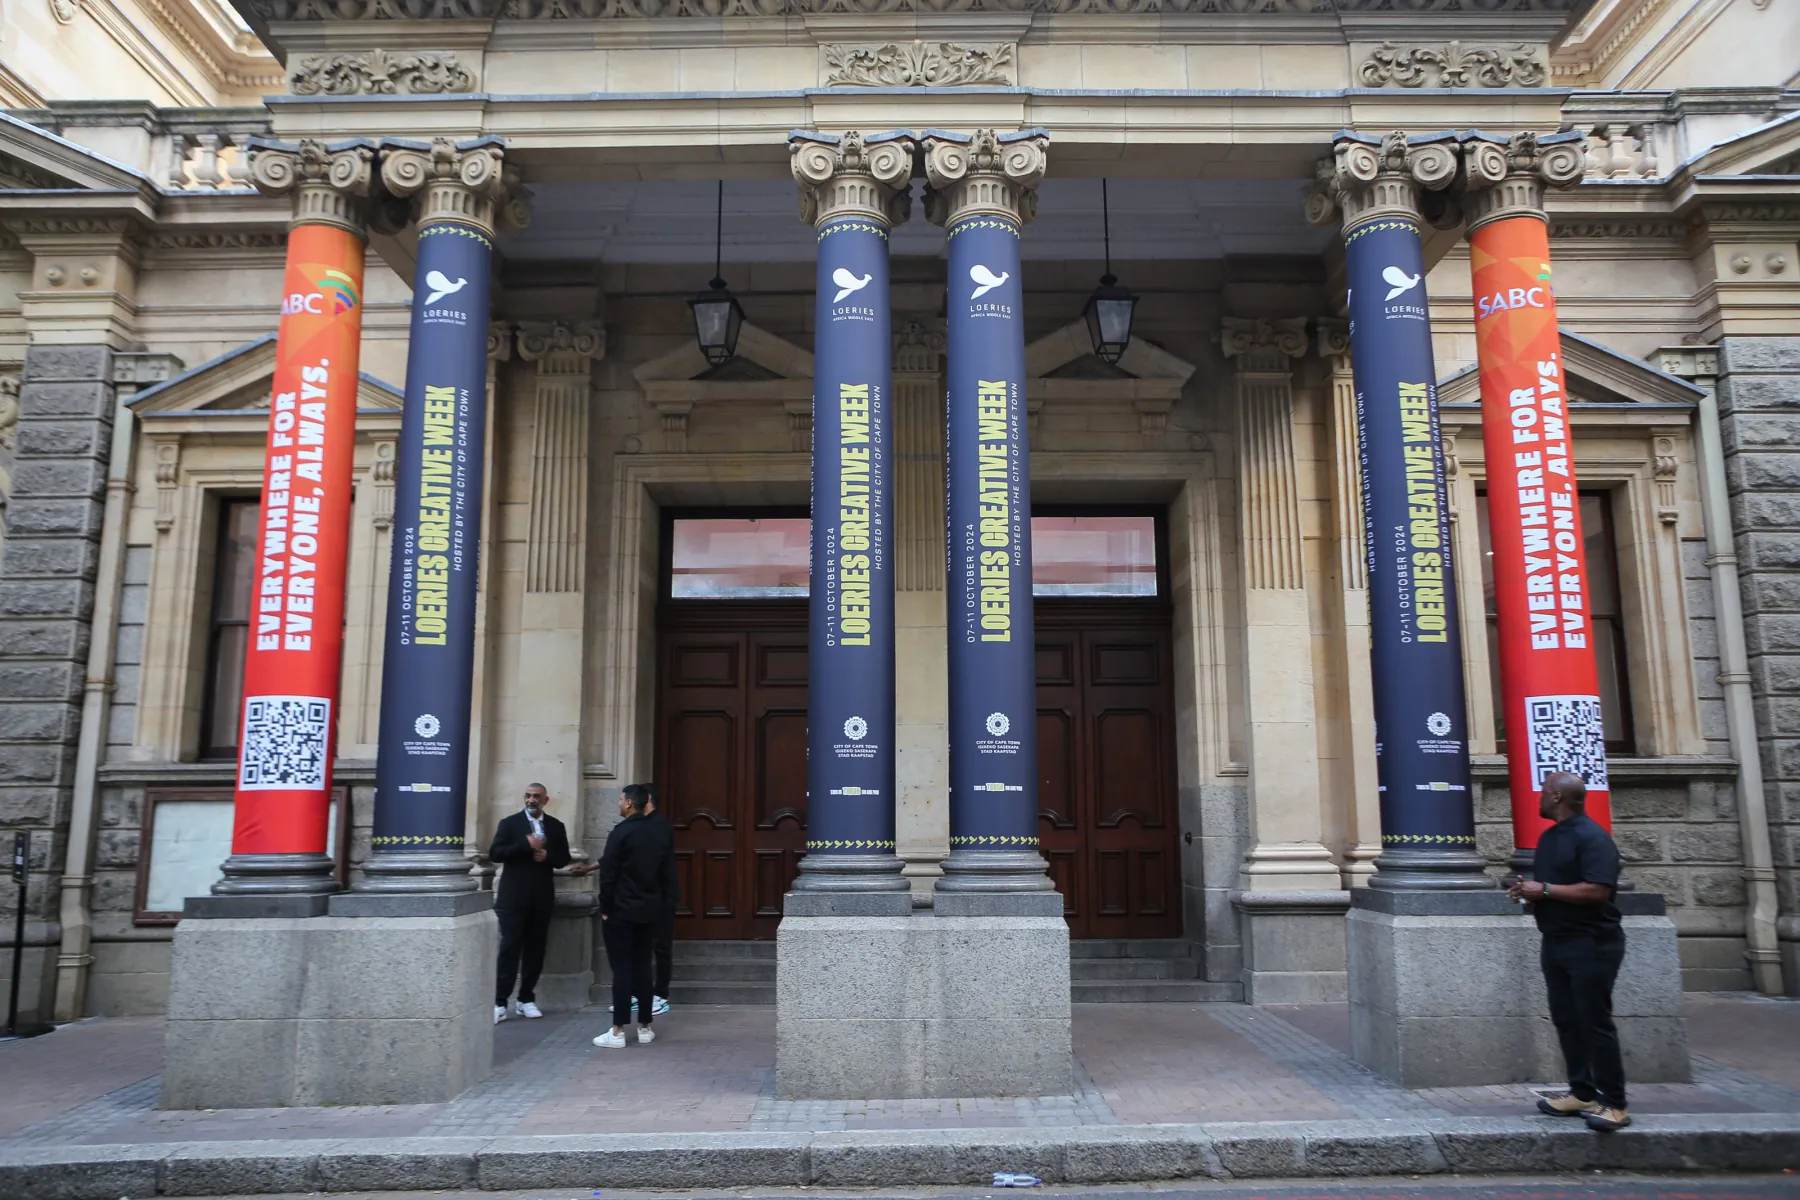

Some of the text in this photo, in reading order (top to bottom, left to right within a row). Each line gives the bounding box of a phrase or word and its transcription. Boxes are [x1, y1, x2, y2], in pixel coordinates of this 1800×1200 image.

[281, 292, 324, 315] ABC
[423, 309, 467, 320] LOERIES
[832, 306, 874, 316] LOERIES
[970, 303, 1011, 314] LOERIES
[1384, 305, 1425, 316] LOERIES
[1478, 286, 1545, 320] SABC
[453, 388, 469, 571] HOSTED BY THE CITY OF CAPE TOWN
[873, 385, 882, 570] HOSTED BY THE CITY OF CAPE TOWN
[1011, 414, 1019, 440] CAPE
[1012, 443, 1019, 456] OF
[1012, 459, 1020, 482] CITY
[256, 391, 297, 651] EVERYWHERE FOR
[283, 358, 329, 651] EVERYONE, ALWAYS.
[414, 384, 456, 646] LOERIES CREATIVE WEEK
[840, 383, 870, 646] LOERIES CREATIVE WEEK
[977, 379, 1011, 642] LOERIES CREATIVE WEEK
[1013, 508, 1020, 522] BY
[1013, 525, 1021, 566] HOSTED
[1398, 382, 1447, 643] LOERIES CREATIVE WEEK
[1509, 387, 1560, 650] EVERYWHERE FOR
[1536, 352, 1587, 649] EVERYONE, ALWAYS.
[400, 527, 414, 645] 07-11 OCTOBER 2024
[827, 527, 835, 647] 07-11 OCTOBER 2024
[965, 523, 976, 643] 07-11 OCTOBER 2024
[1394, 525, 1412, 643] 07-11 OCTOBER 2024
